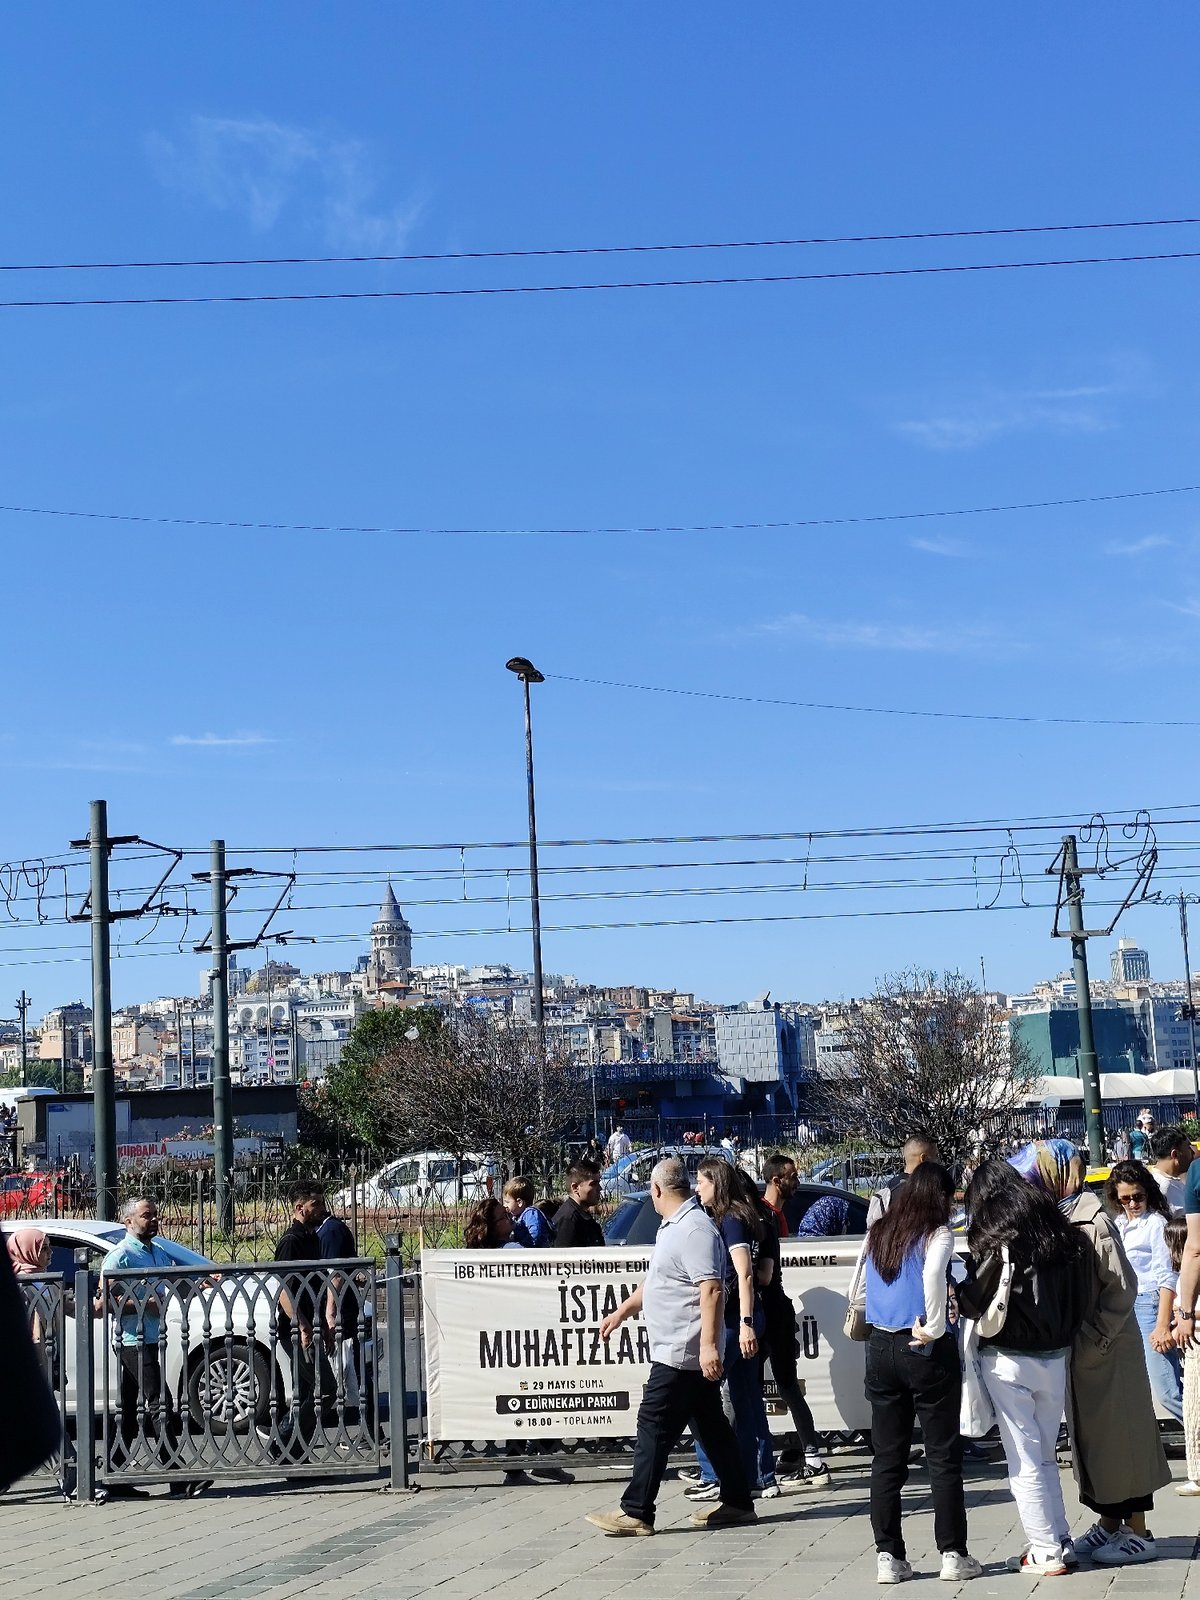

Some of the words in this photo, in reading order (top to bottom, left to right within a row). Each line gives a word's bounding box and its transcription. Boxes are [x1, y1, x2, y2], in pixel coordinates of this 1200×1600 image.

[454, 1262, 475, 1279] İBB
[479, 1263, 552, 1279] MEHTERANI
[556, 1259, 622, 1278] EŞLİĞİNDE
[558, 1279, 646, 1323] İSTAN
[533, 1381, 544, 1390] 29
[547, 1380, 576, 1390] MAYIS
[579, 1379, 604, 1389] CUMA
[525, 1396, 585, 1410] EDİRNEKAPI
[587, 1395, 617, 1408] PARKI
[527, 1417, 552, 1427] 18.00
[563, 1416, 612, 1426] TOPLANMA
